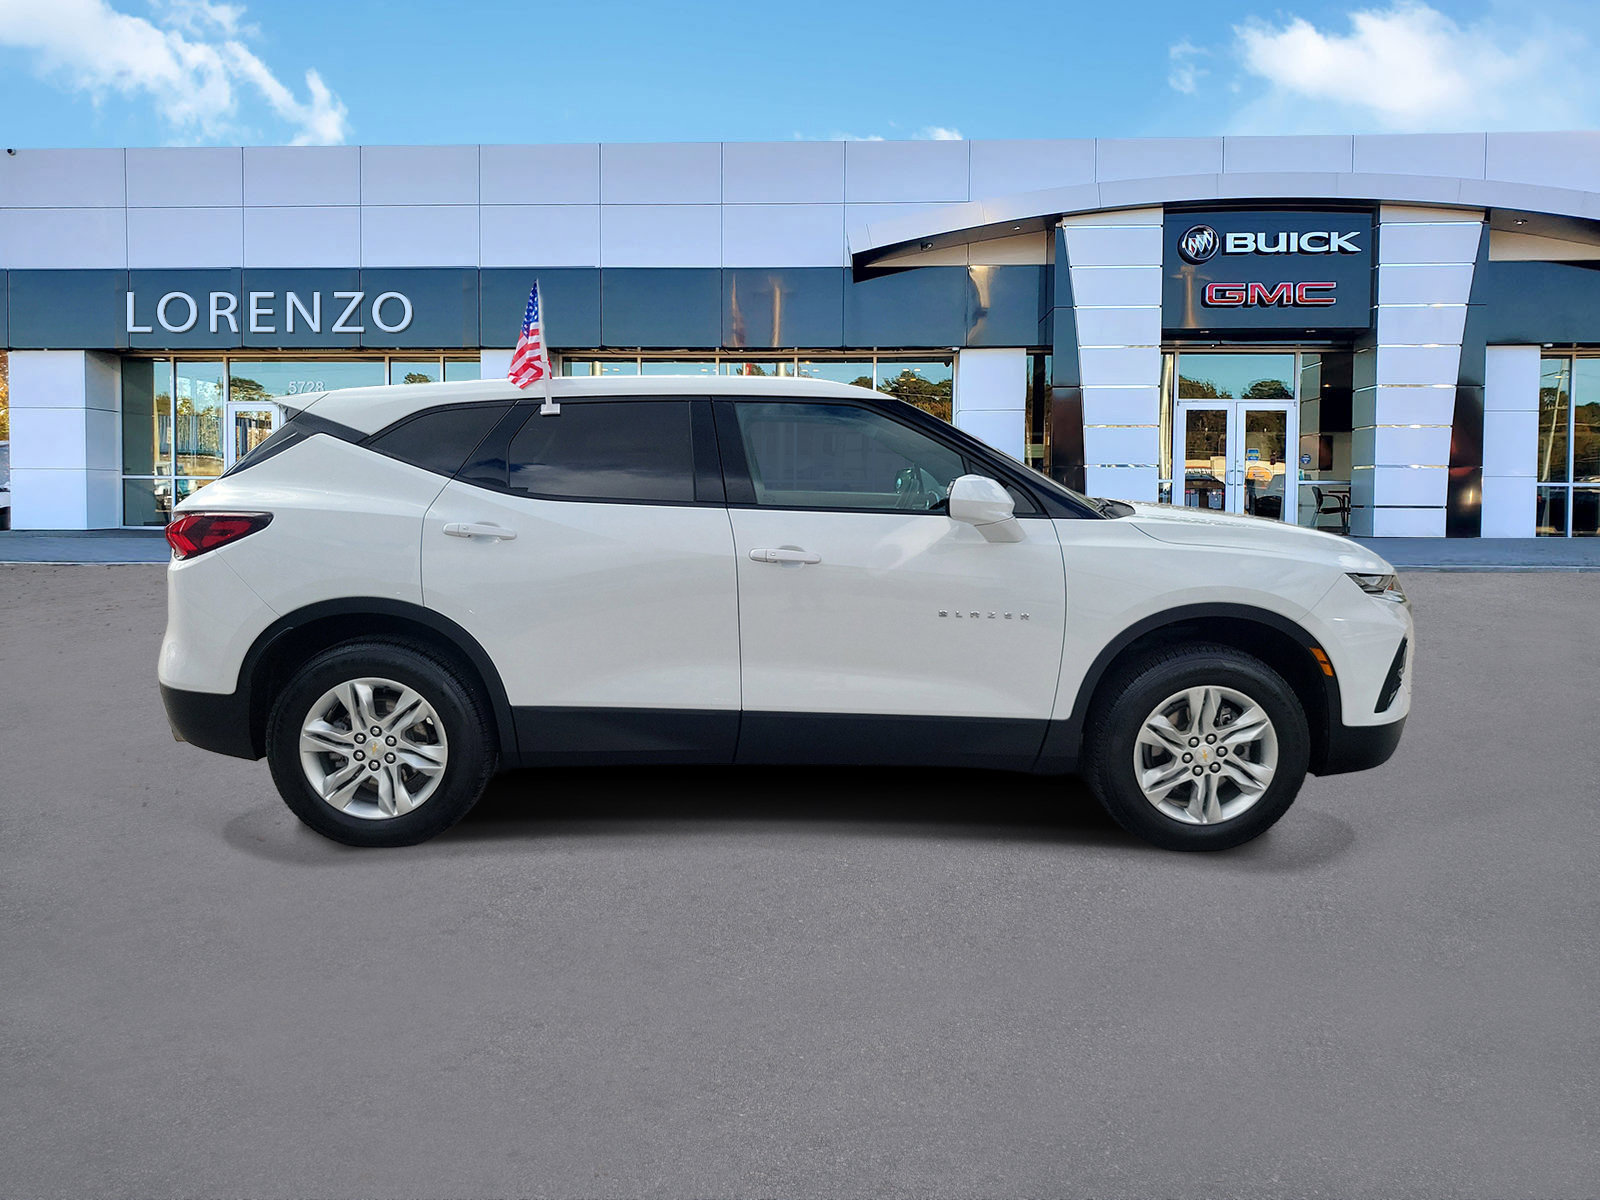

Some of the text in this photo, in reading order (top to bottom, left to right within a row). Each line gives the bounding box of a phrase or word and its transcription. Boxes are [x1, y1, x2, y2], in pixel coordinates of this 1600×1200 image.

[1226, 231, 1361, 253] BUICK
[1206, 282, 1337, 305] GMC
[126, 291, 413, 333] LORENZO
[288, 381, 325, 394] 5728
[938, 609, 1030, 621] BLAZER
